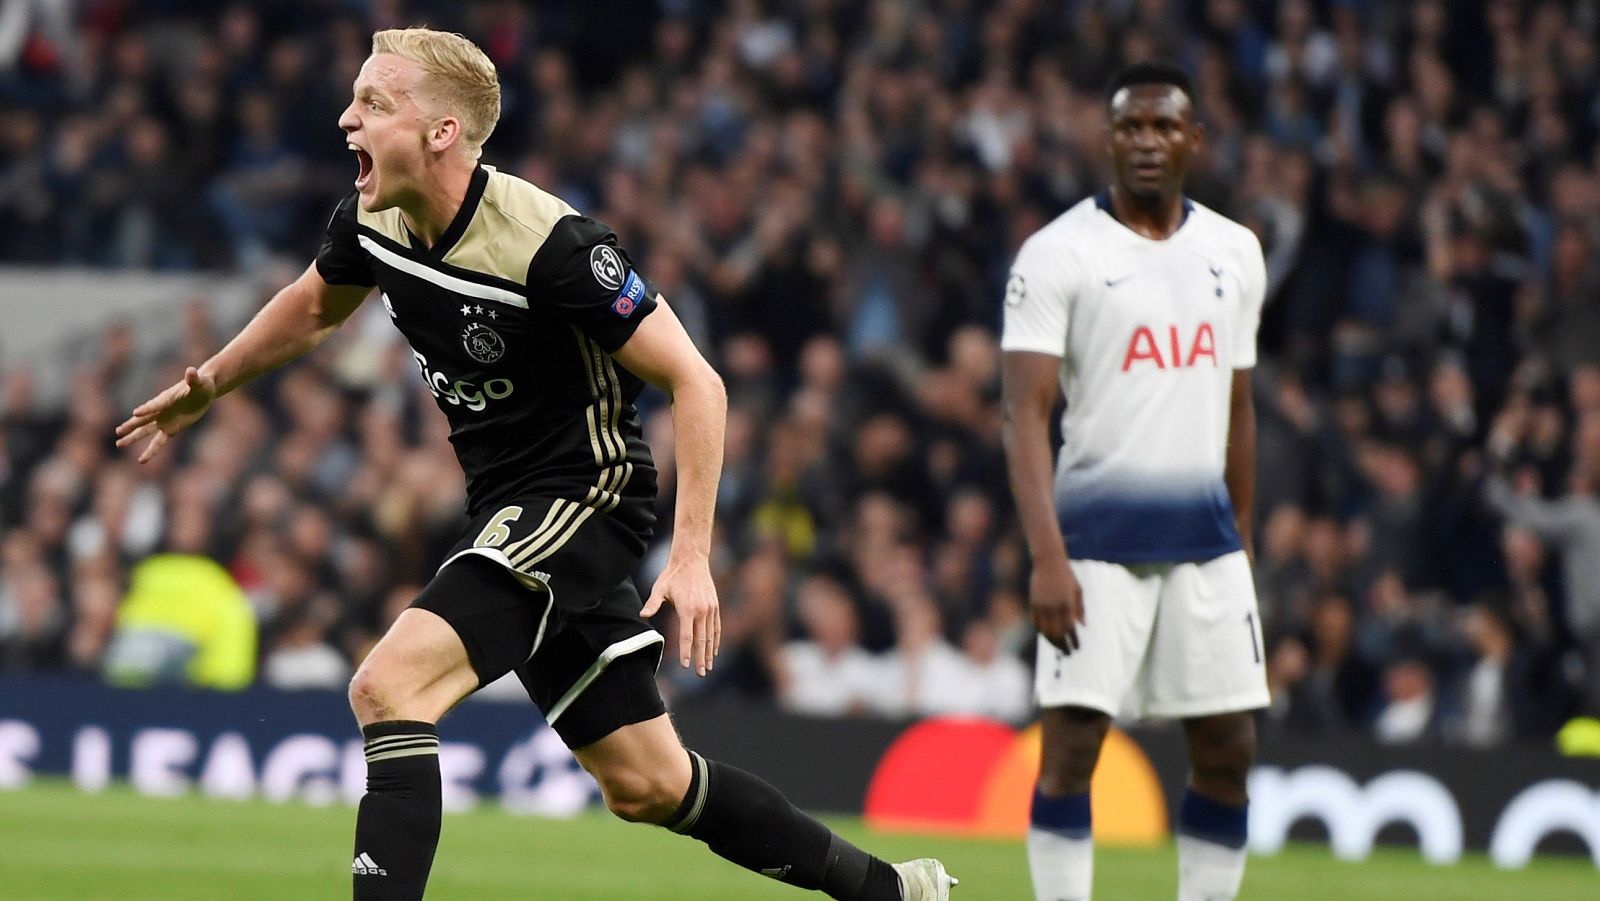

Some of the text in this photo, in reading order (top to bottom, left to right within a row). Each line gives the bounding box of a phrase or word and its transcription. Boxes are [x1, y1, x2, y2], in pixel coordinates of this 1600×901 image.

[461, 321, 480, 341] AJAX
[1121, 321, 1219, 373] AIA
[473, 505, 525, 549] 6
